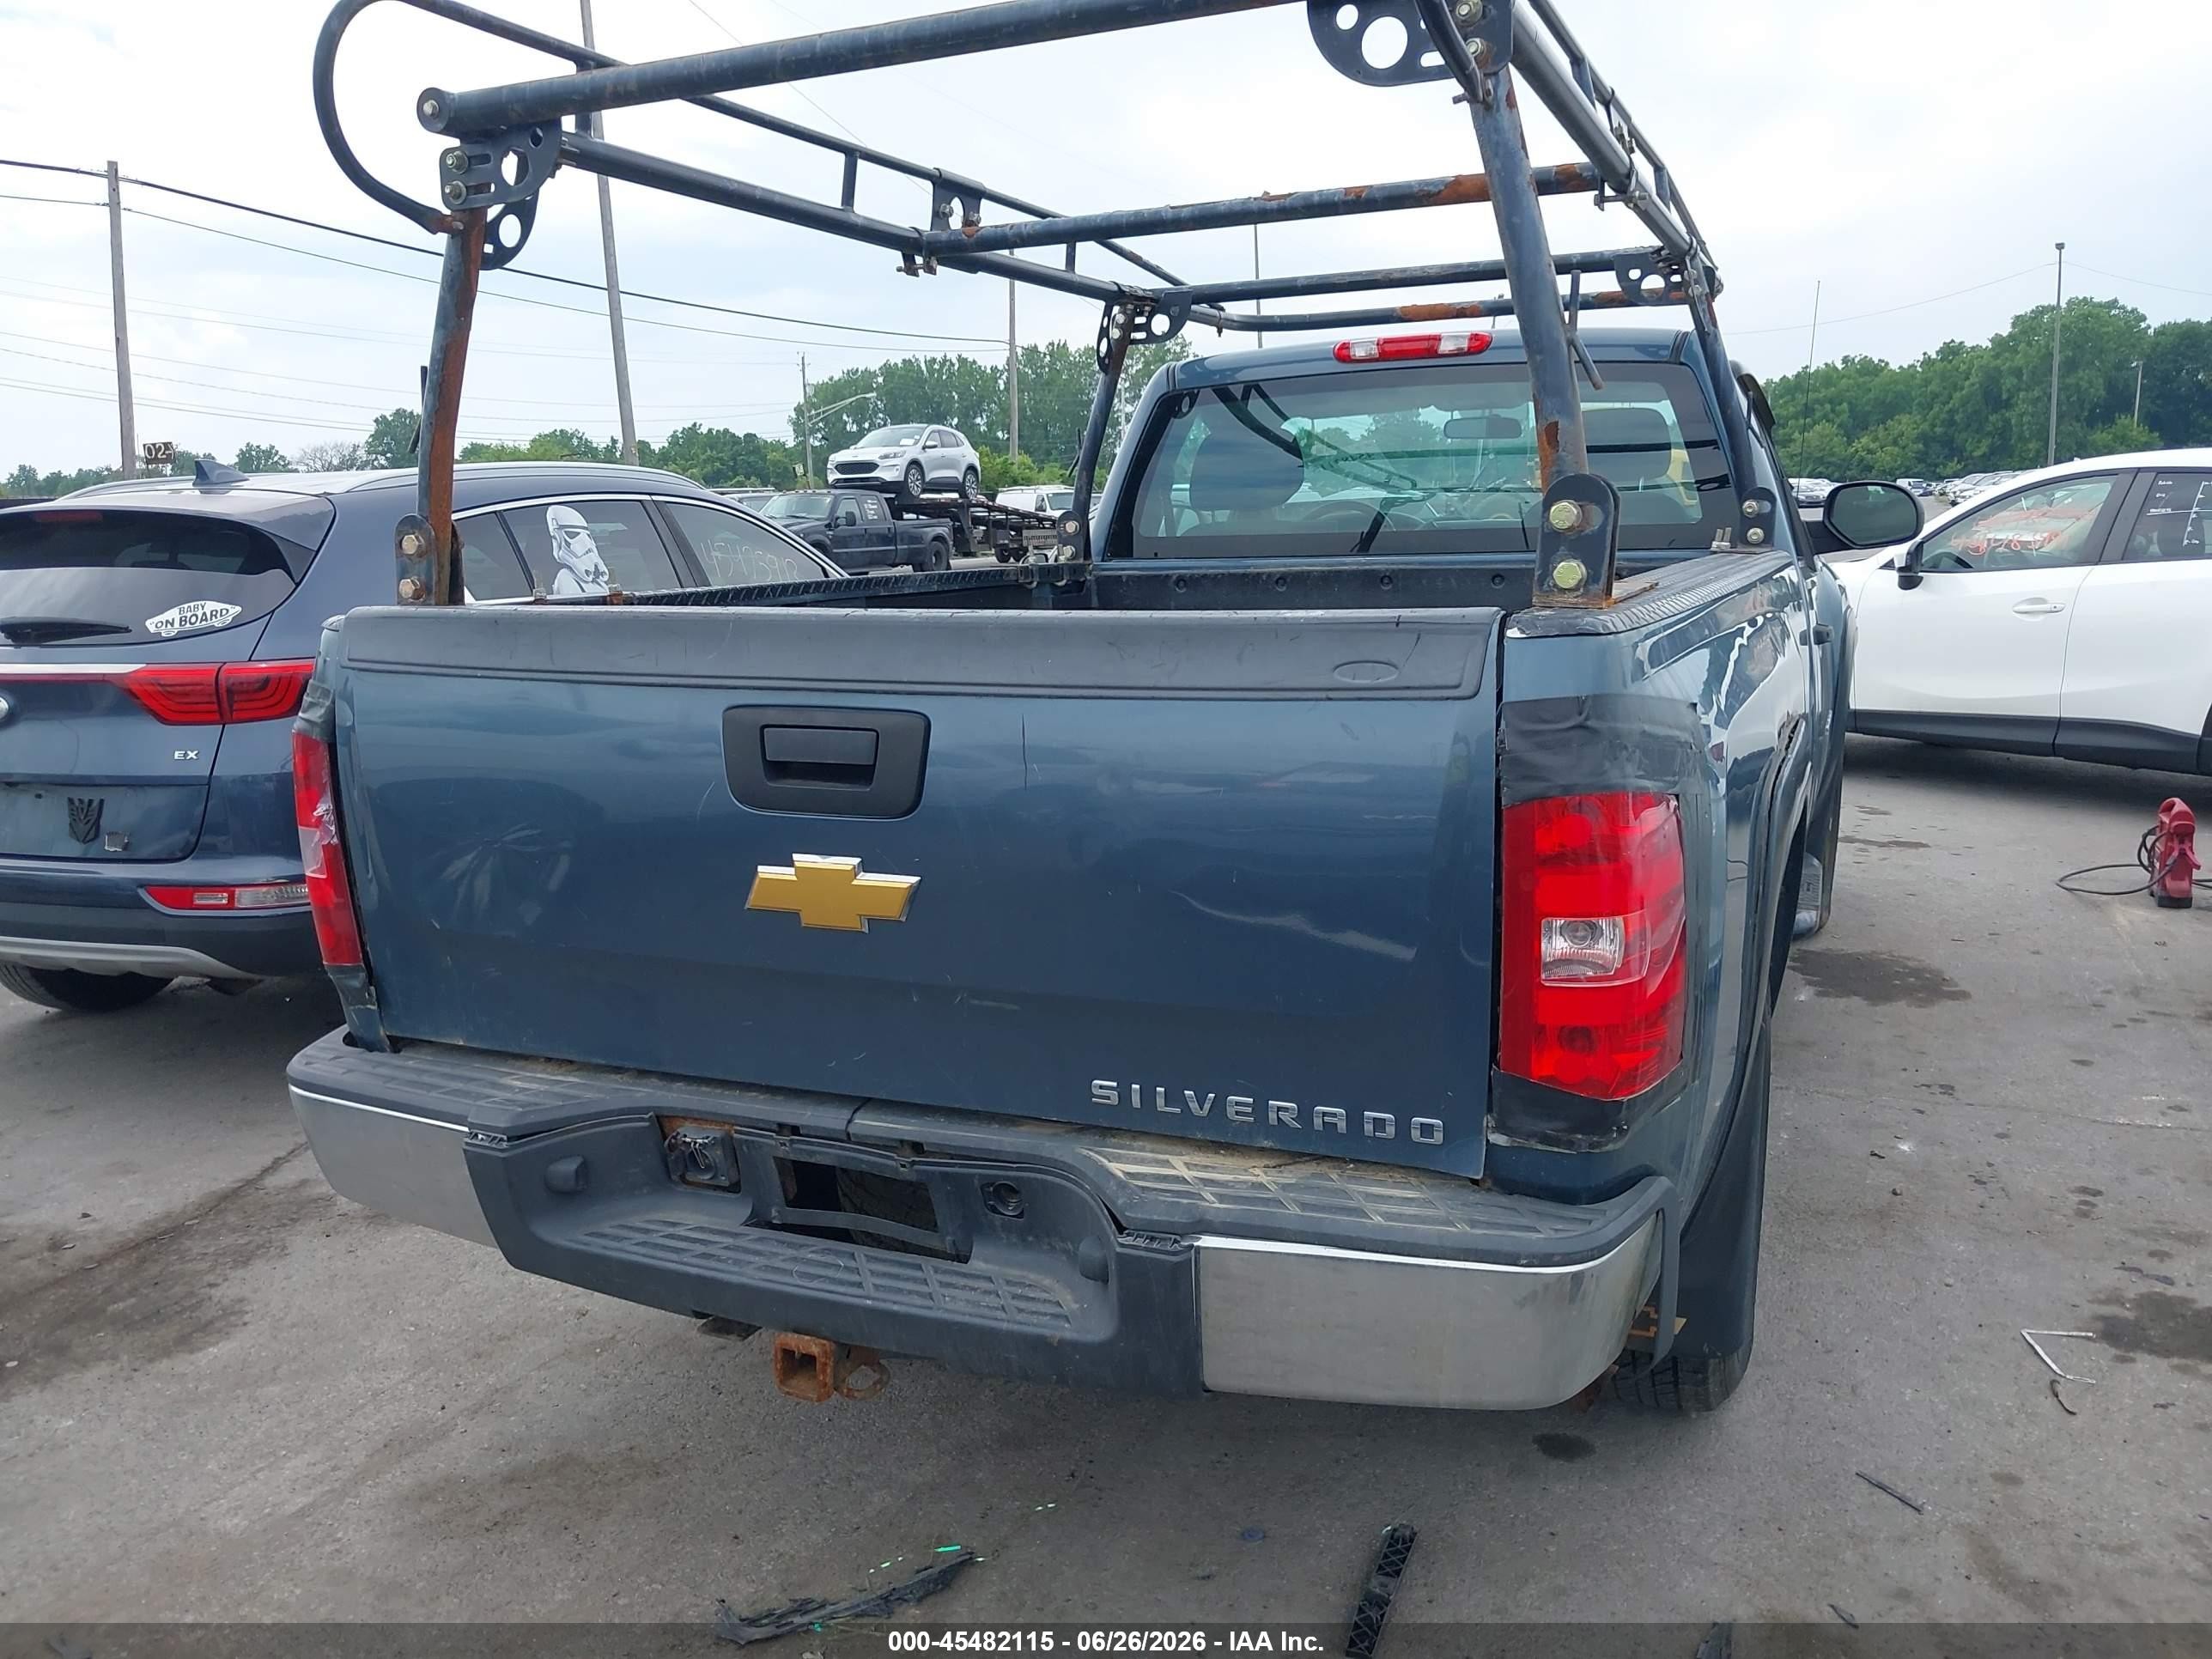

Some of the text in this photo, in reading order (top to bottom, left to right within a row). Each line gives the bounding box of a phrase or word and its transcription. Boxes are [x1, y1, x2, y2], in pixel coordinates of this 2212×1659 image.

[178, 602, 206, 616] BABY
[173, 750, 199, 760] EX
[1090, 1079, 1444, 1146] SILVERADO
